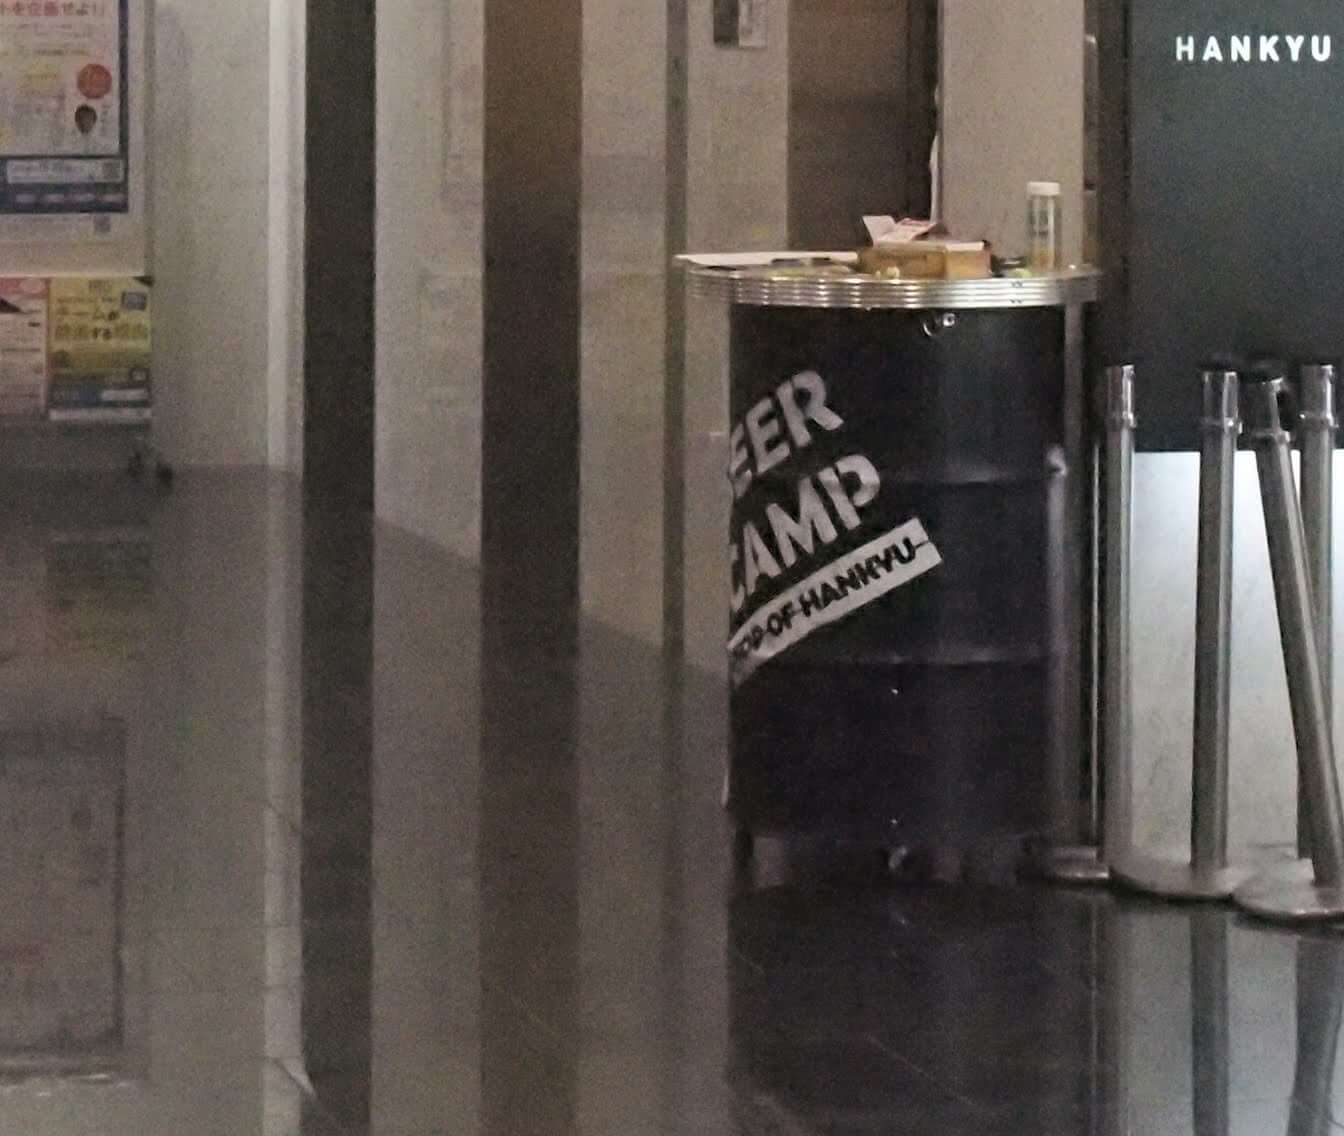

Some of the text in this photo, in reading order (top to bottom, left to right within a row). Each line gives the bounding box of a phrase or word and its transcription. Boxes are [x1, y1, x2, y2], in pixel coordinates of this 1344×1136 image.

[1174, 34, 1332, 63] HANKYU
[729, 369, 845, 498] EER
[729, 454, 882, 612] AMP
[798, 536, 917, 618] HANKYU
